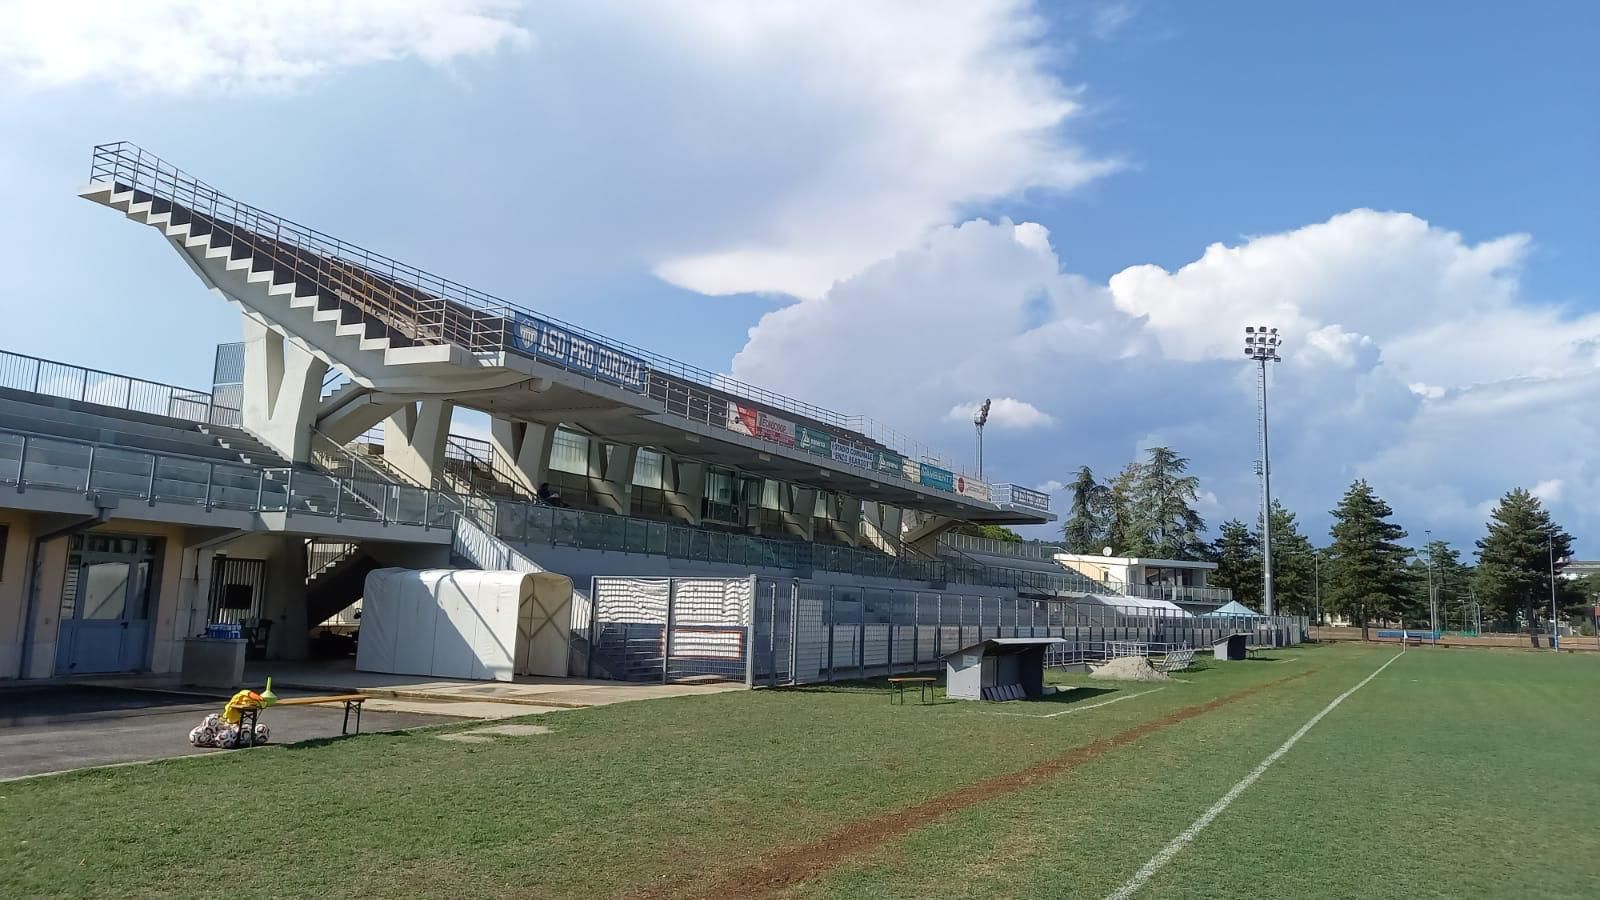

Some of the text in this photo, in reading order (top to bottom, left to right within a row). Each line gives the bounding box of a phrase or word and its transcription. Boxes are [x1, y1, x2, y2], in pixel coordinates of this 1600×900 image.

[539, 327, 640, 386] ASD PRO GORIZIA
